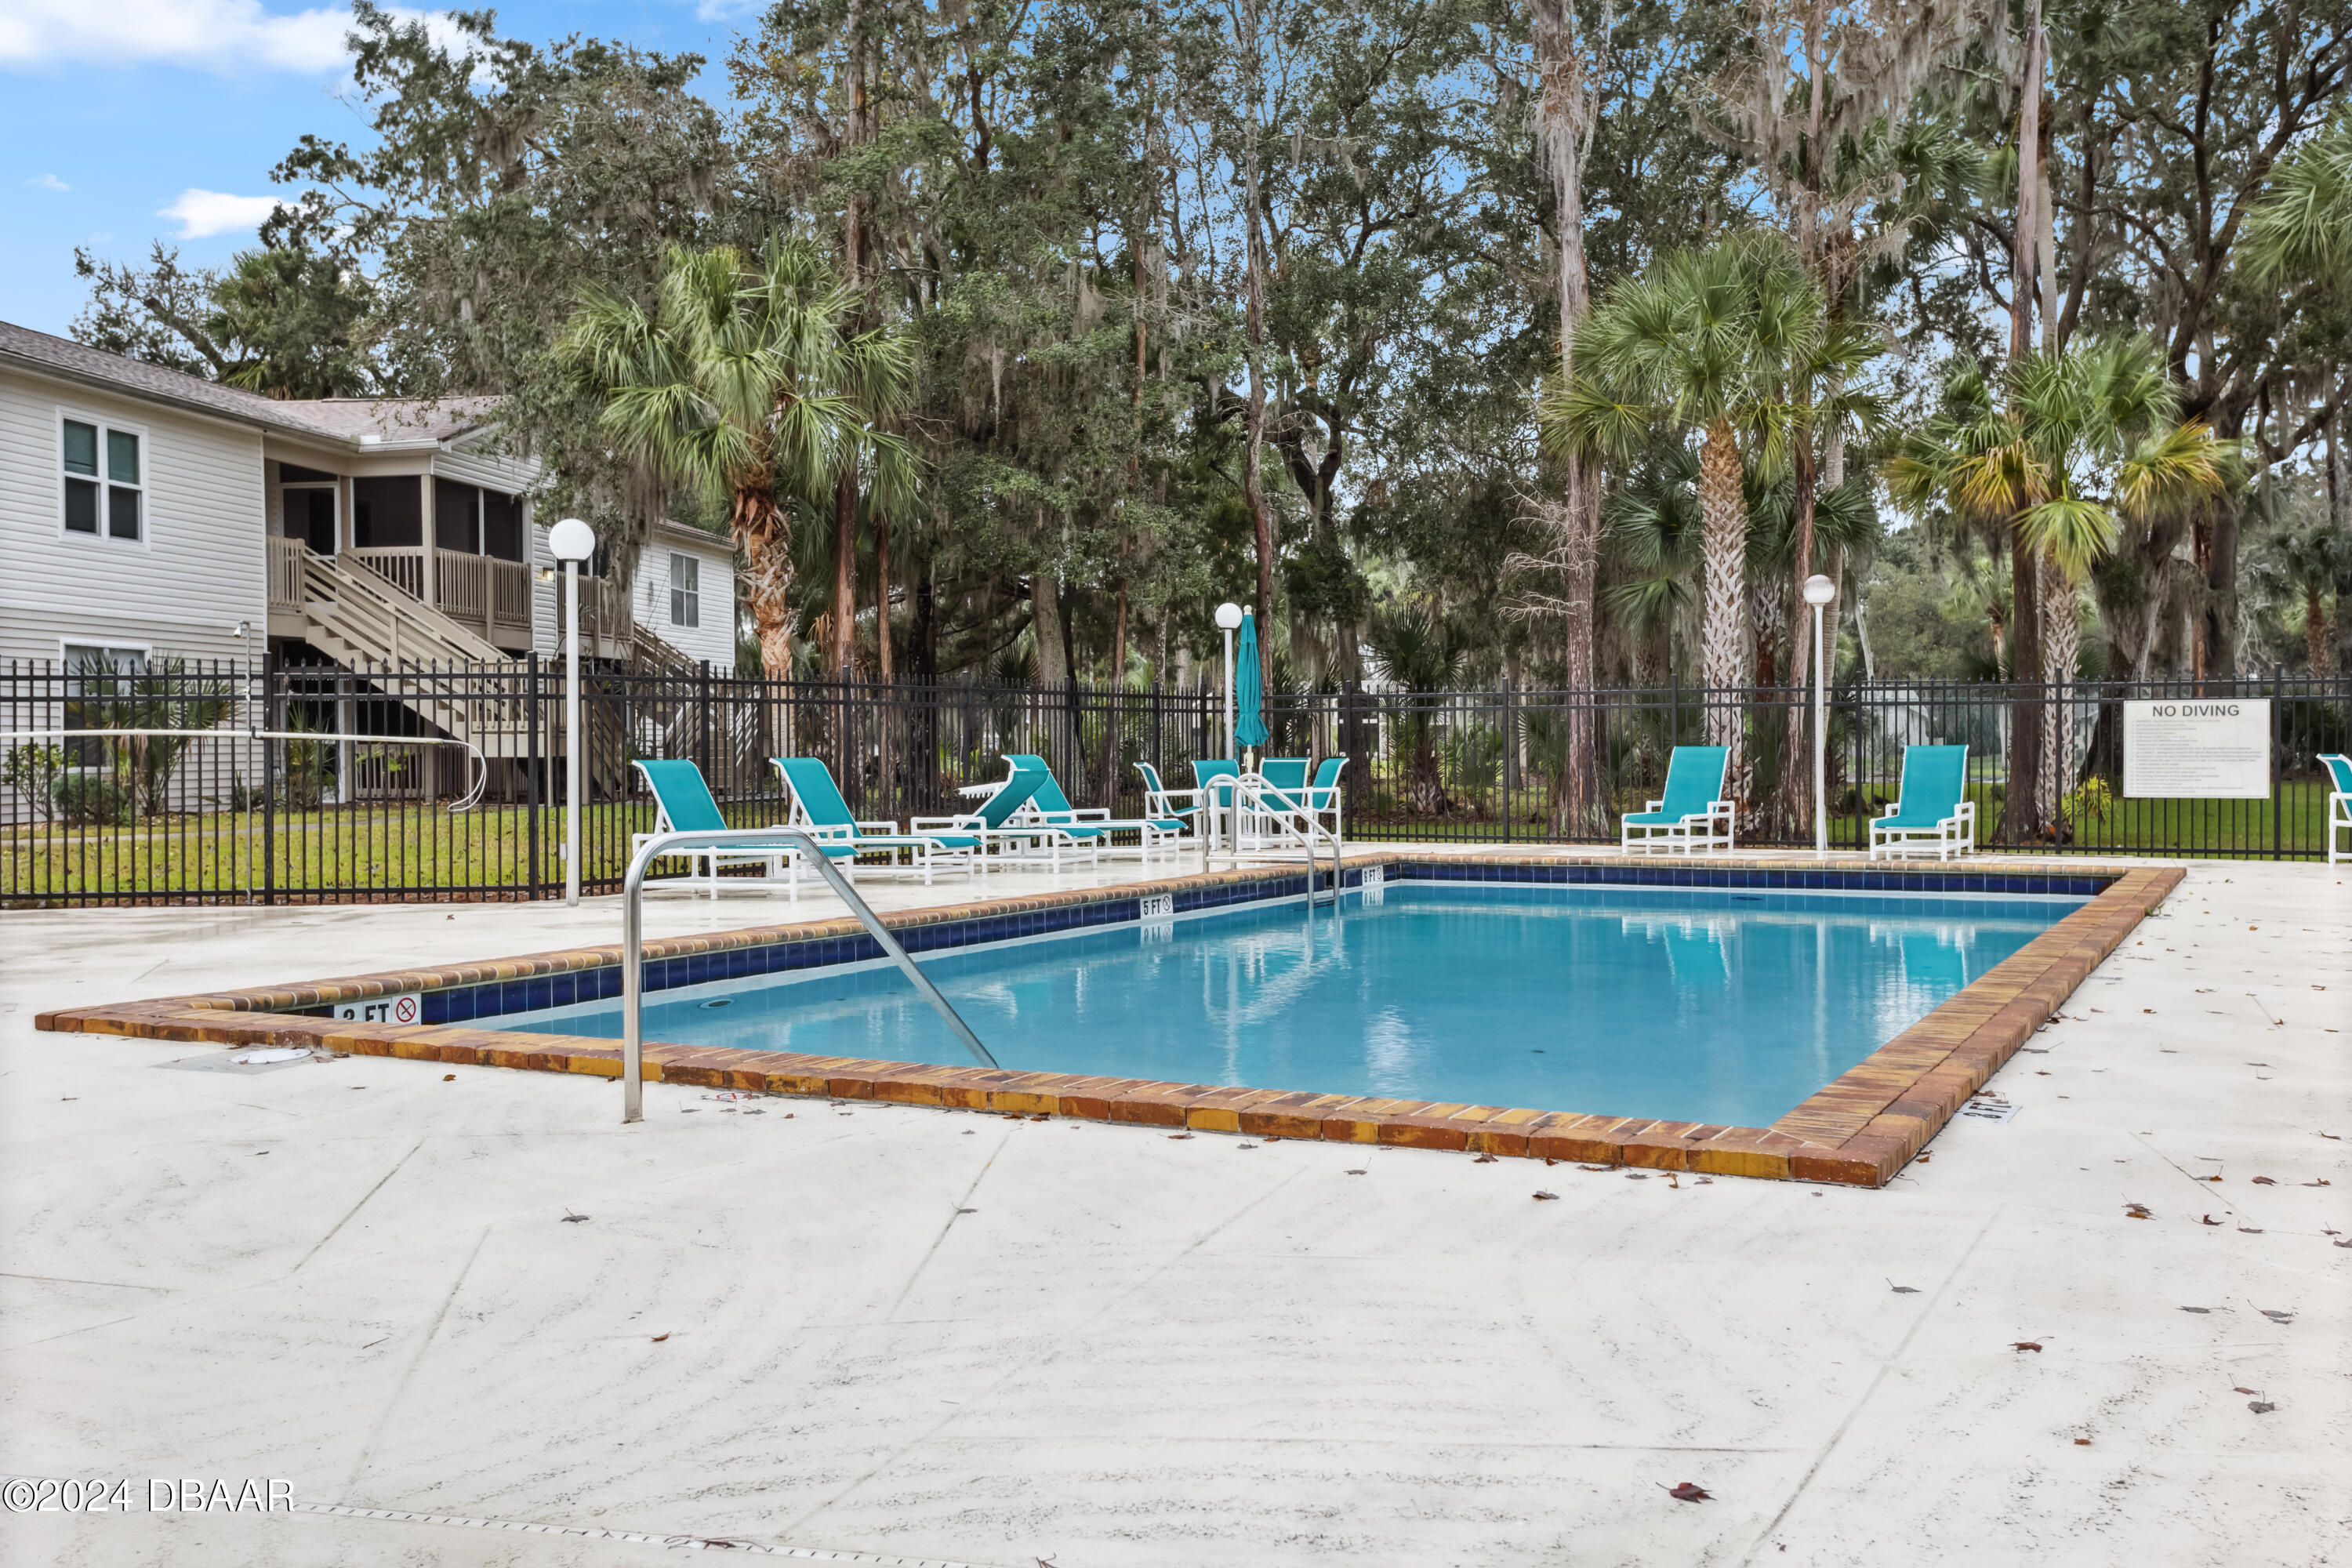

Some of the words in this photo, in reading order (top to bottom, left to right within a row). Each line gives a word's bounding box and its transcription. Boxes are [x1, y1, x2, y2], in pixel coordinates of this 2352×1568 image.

[2153, 706, 2176, 717] NO
[2183, 705, 2240, 717] DIVING
[1364, 871, 1368, 884] 6
[1369, 869, 1376, 883] FT
[1144, 900, 1149, 916] 5
[1152, 898, 1161, 915] FT
[365, 1003, 390, 1023] FT
